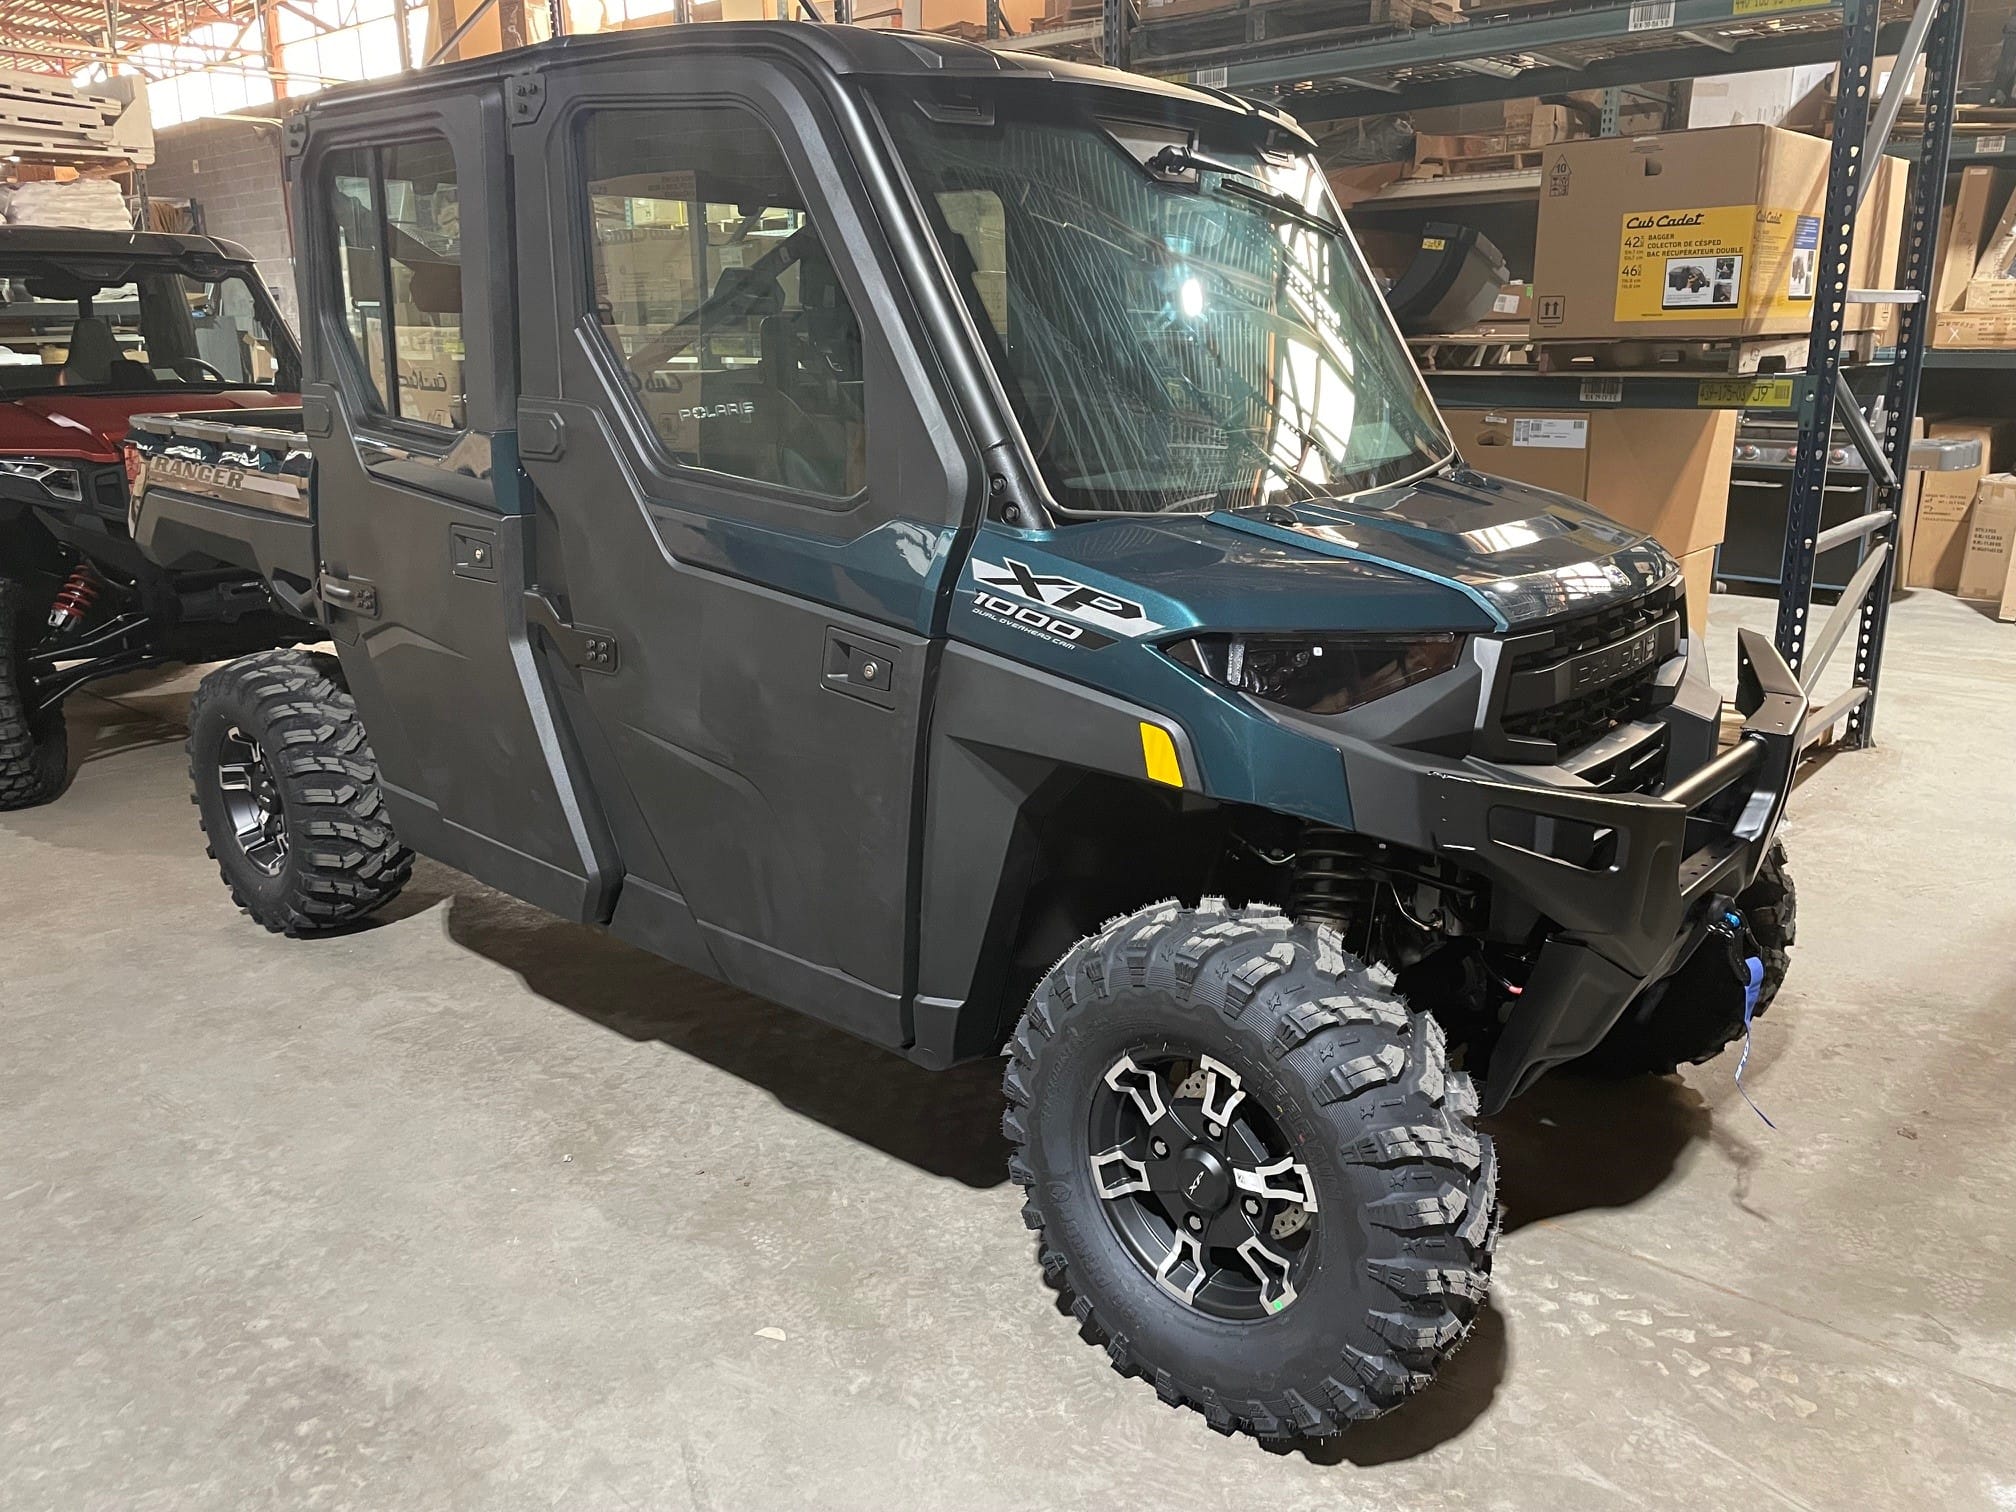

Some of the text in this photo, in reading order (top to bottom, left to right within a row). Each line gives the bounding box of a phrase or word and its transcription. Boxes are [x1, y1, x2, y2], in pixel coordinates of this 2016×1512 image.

[1557, 163, 1567, 173] 10
[1626, 213, 1704, 229] Cub Cadet
[1624, 236, 1641, 248] 42
[1647, 241, 1682, 249] COLECTOR
[1648, 233, 1675, 241] BAGGER
[1716, 246, 1743, 254] DOUBLE
[1621, 264, 1638, 277] 46
[679, 402, 755, 421] POLARIS
[156, 455, 246, 490] RANGER
[979, 557, 1144, 619] XP
[973, 591, 1084, 640] 1000
[972, 607, 1076, 651] DUAL OVERHEAD CAM
[1188, 1170, 1205, 1196] XP
